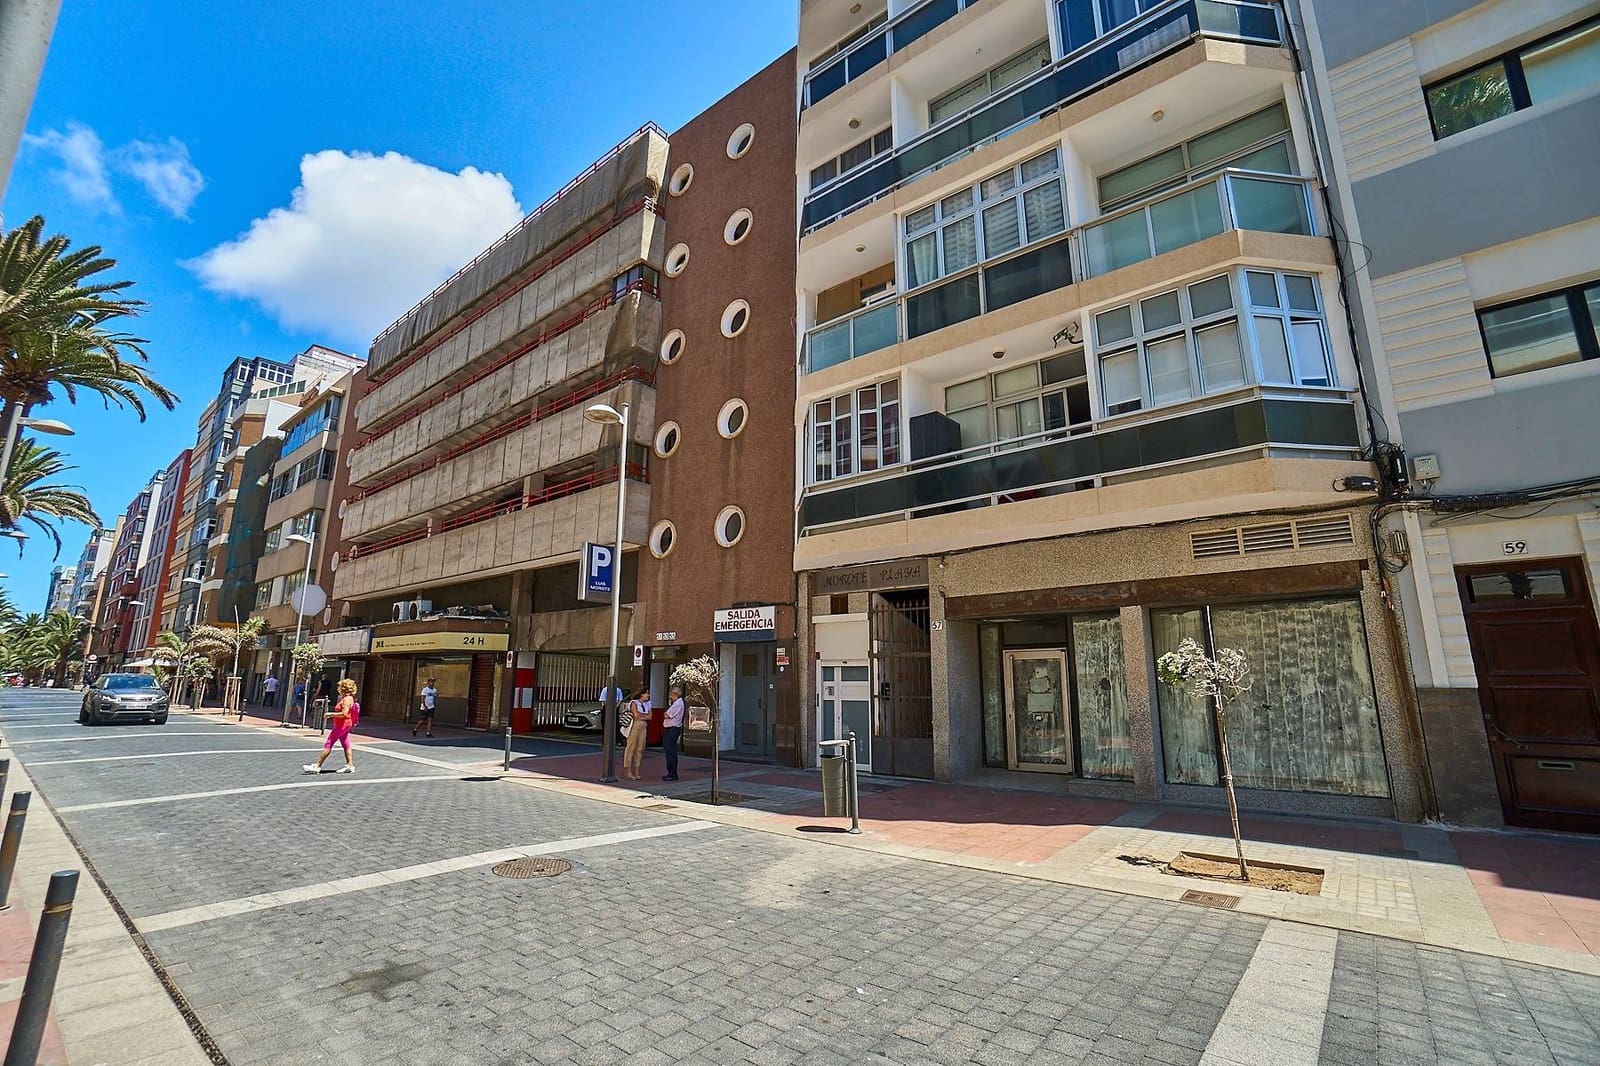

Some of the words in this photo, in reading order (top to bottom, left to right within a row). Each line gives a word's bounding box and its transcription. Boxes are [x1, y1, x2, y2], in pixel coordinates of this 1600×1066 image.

[1505, 541, 1526, 554] 59
[591, 545, 612, 577] P
[823, 571, 868, 589] MOROTE
[881, 565, 920, 581] PLAYA
[727, 609, 761, 620] SALIDA
[715, 618, 774, 631] EMERGENCIA
[931, 621, 943, 631] 57
[463, 636, 475, 645] 24
[477, 637, 485, 646] H
